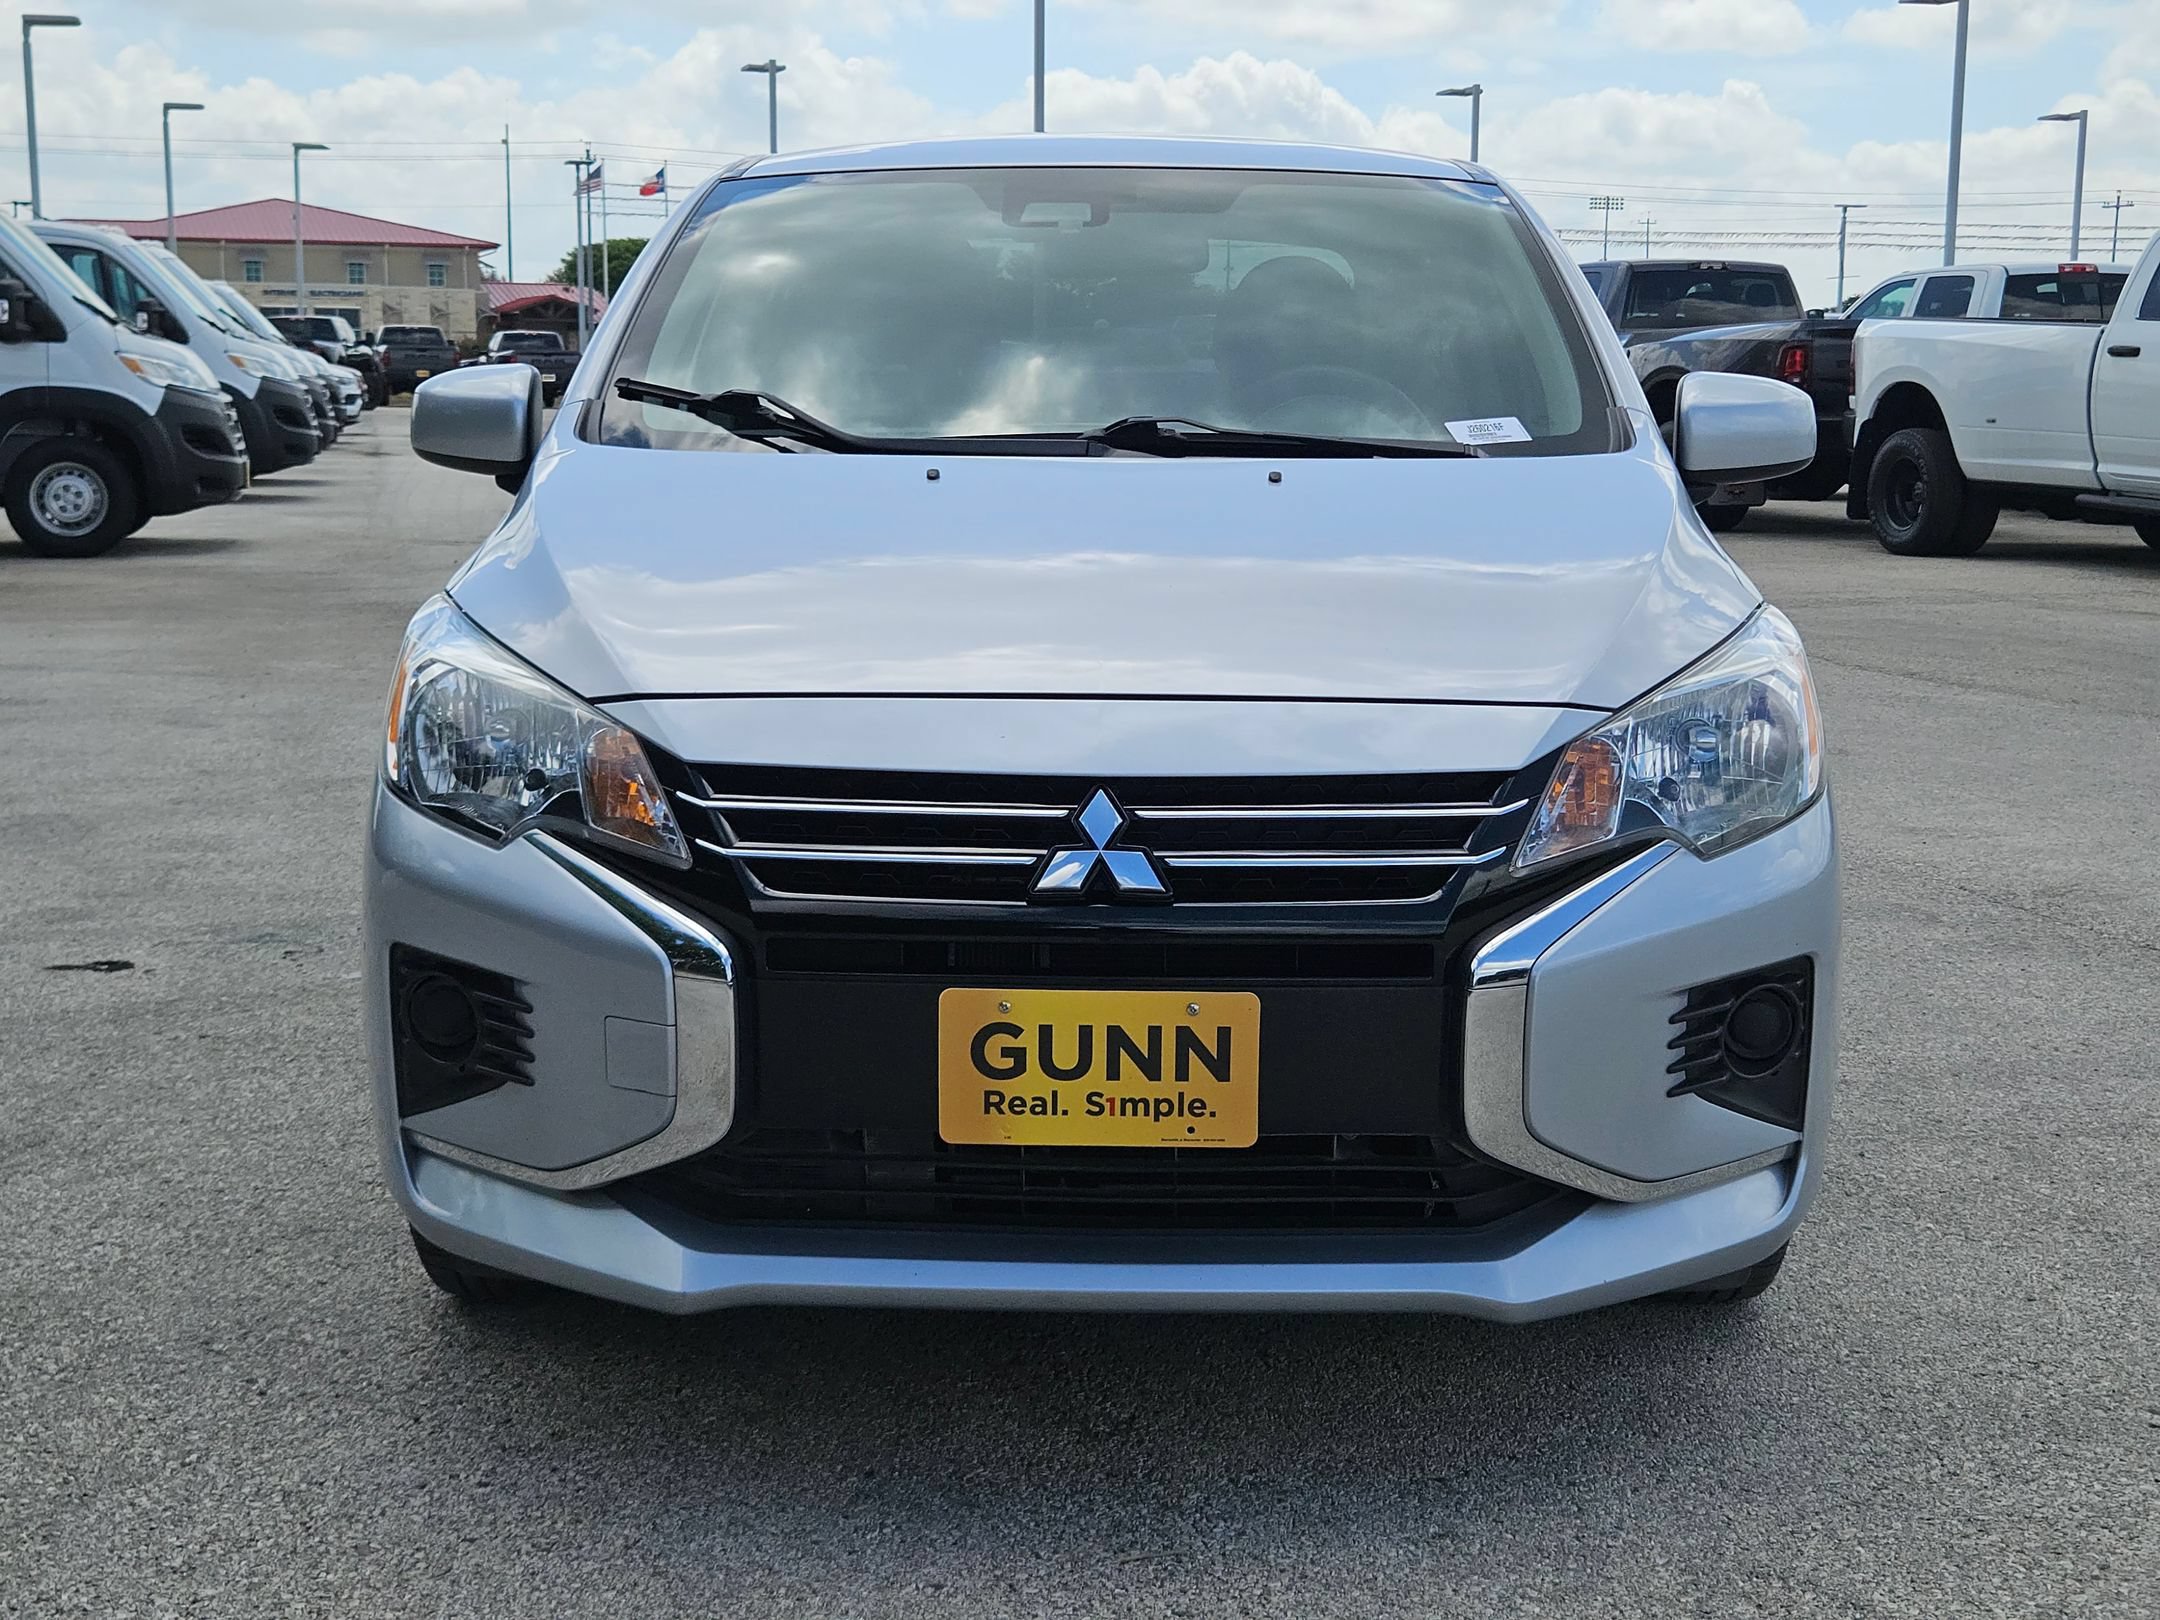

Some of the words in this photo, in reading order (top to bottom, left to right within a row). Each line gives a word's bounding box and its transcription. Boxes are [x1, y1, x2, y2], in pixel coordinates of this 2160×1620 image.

[970, 1021, 1232, 1083] GUNN
[983, 1089, 1069, 1117] Real.
[1085, 1091, 1217, 1122] S1mple.
